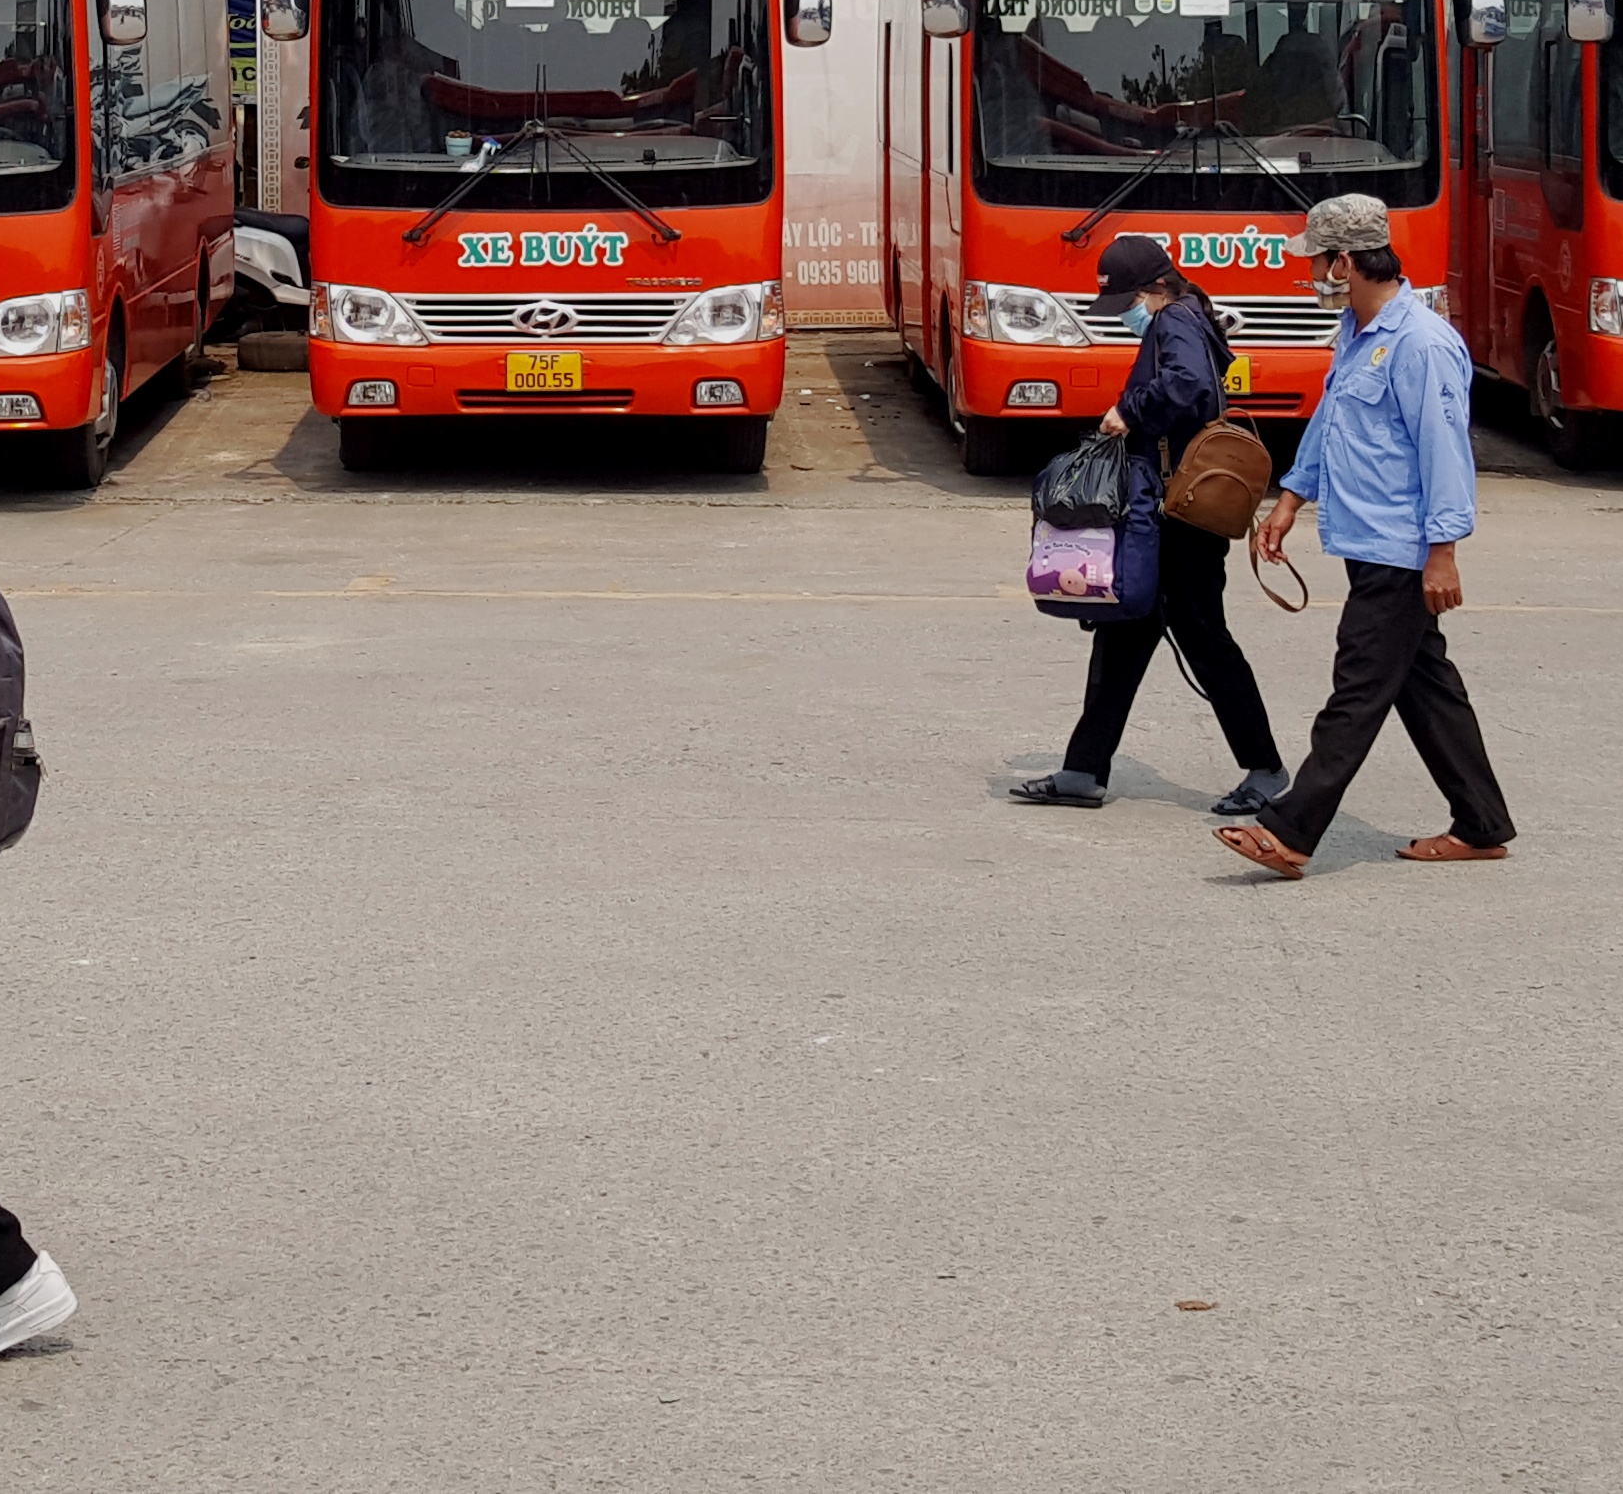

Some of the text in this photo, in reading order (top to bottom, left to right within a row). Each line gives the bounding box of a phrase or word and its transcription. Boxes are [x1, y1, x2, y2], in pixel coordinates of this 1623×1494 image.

[458, 223, 628, 267] XE BUÝT
[808, 217, 842, 252] LỘC
[1179, 225, 1290, 268] BUÝT
[798, 260, 842, 285] 0935
[846, 259, 880, 285] 960
[528, 355, 560, 371] 75F
[514, 372, 574, 389] 000.55
